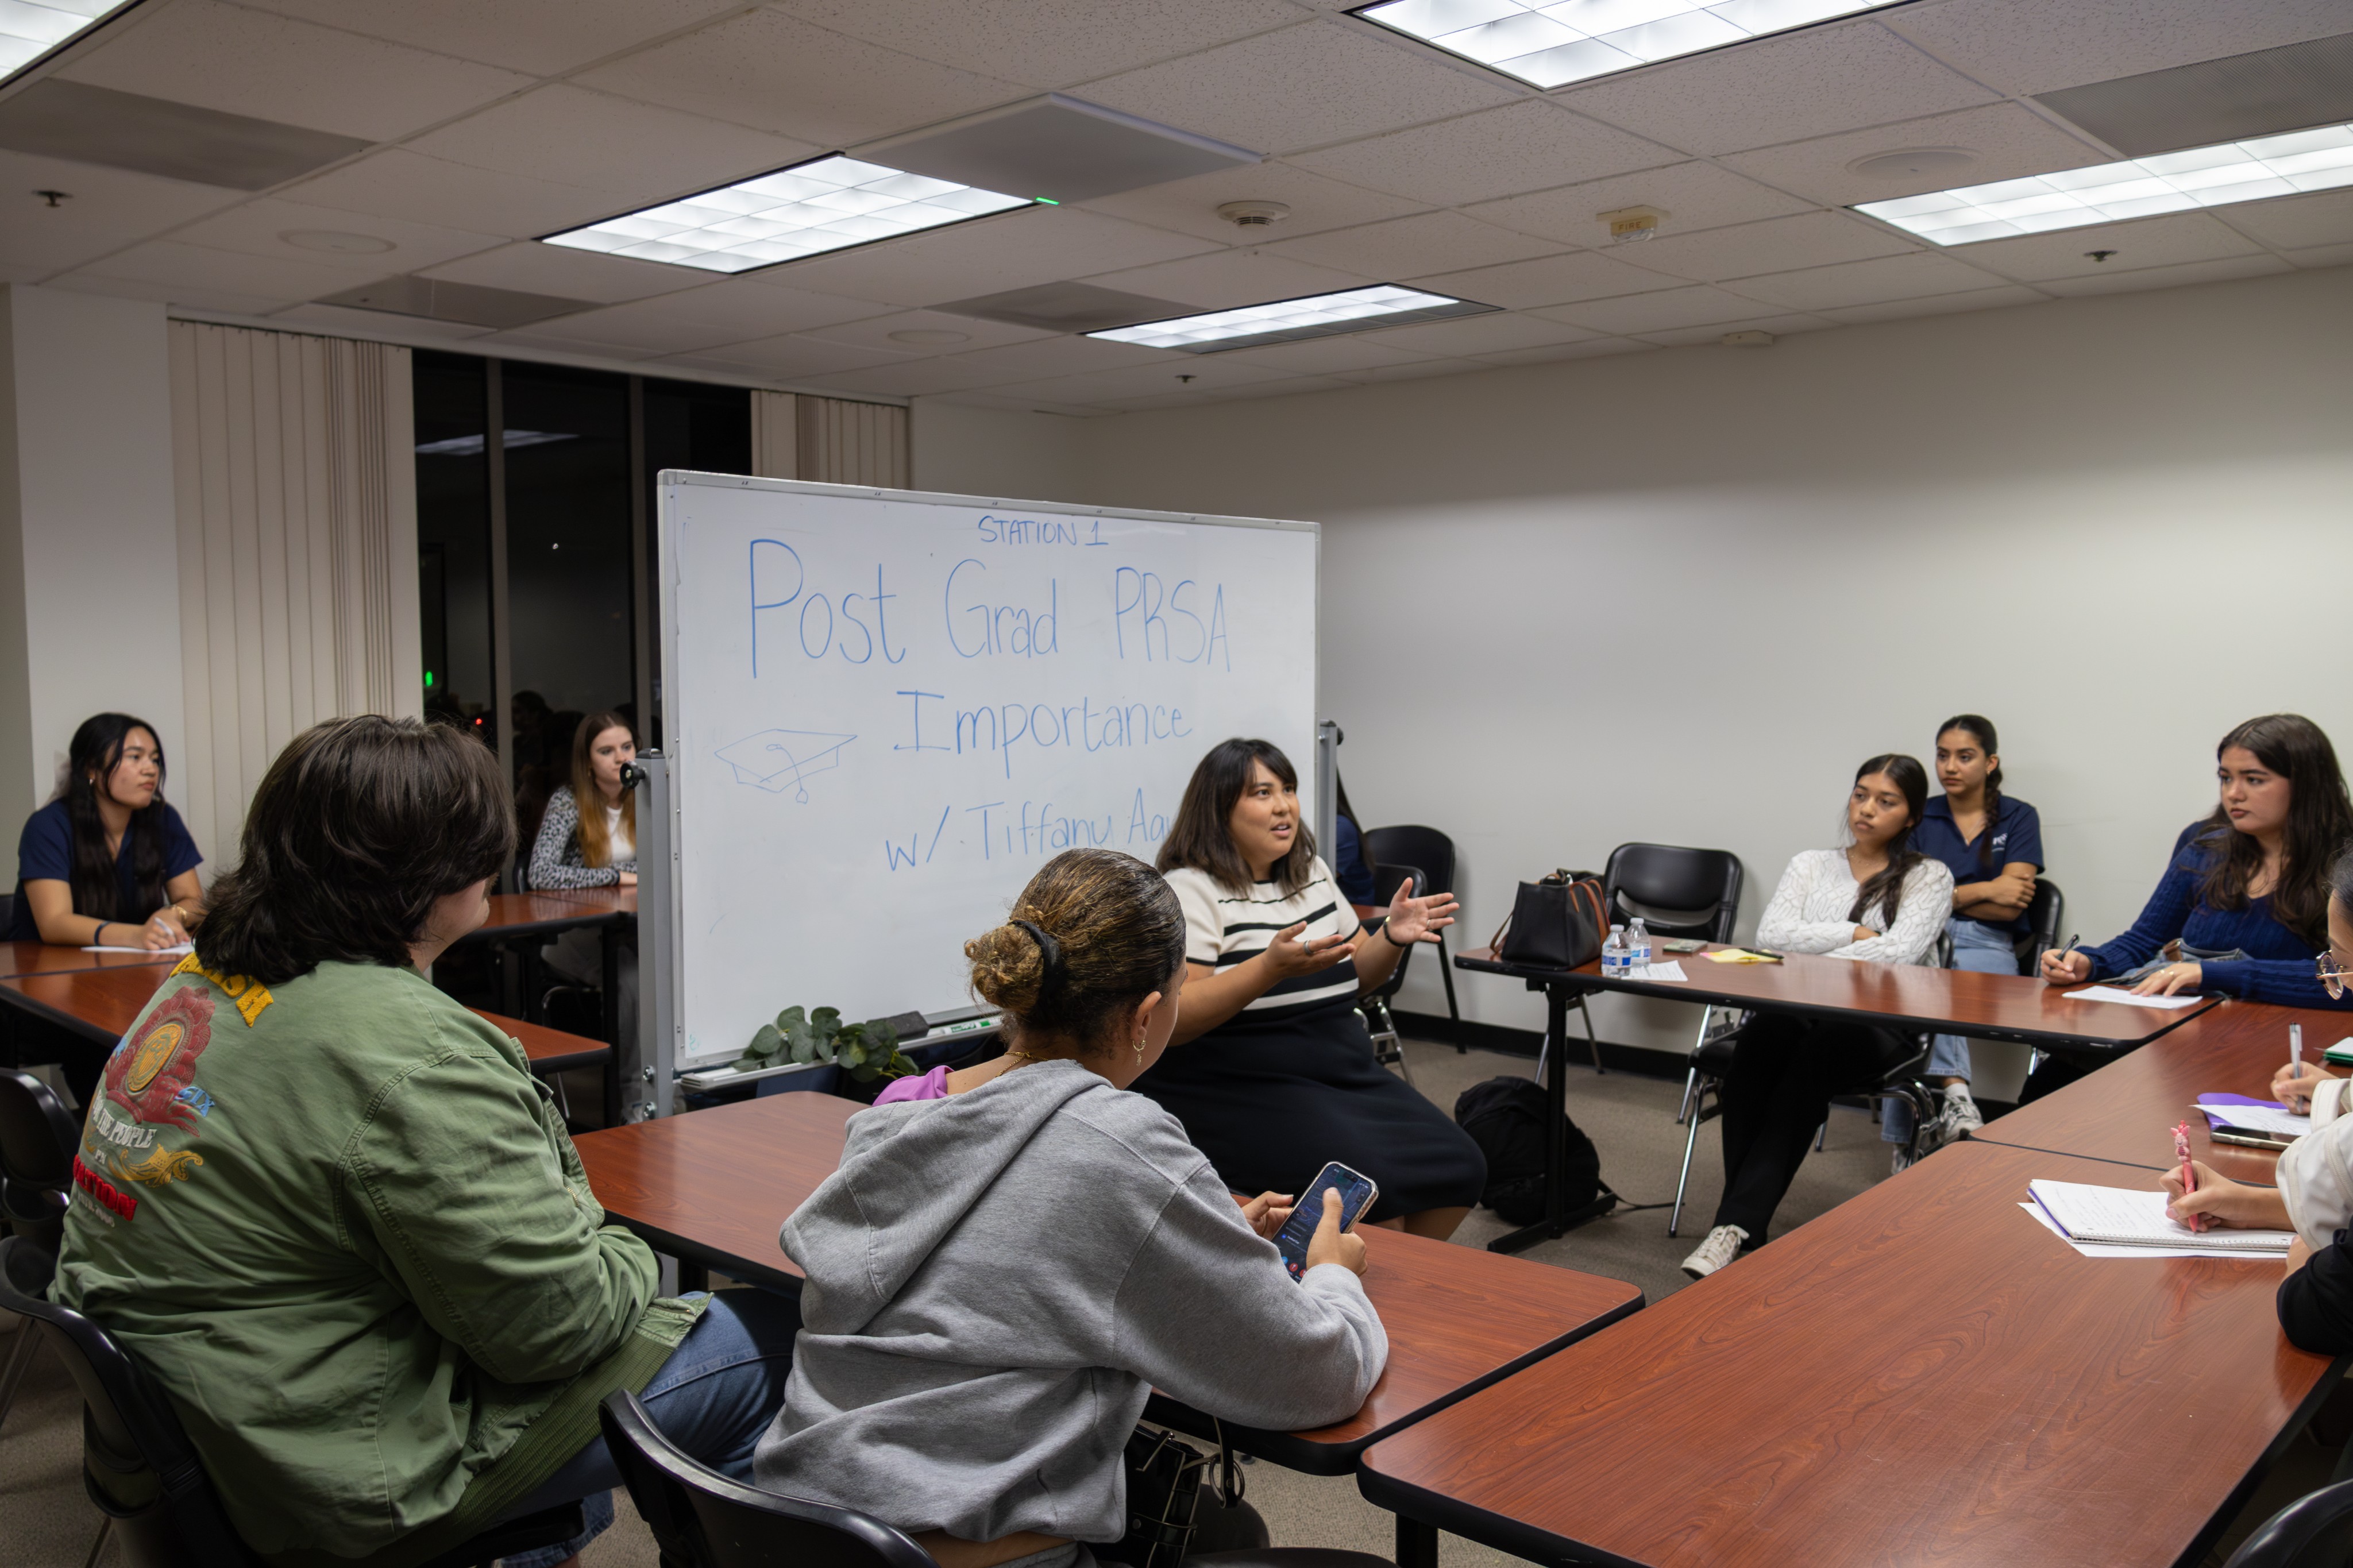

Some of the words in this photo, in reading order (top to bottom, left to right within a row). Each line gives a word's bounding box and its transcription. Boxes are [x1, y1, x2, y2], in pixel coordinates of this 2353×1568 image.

[1618, 221, 1642, 230] FIRE
[978, 516, 1078, 546] STATION
[1085, 519, 1109, 546] 1
[750, 539, 906, 679] Post
[946, 559, 1058, 658] Grad
[1116, 567, 1230, 671] PRSA
[894, 690, 1192, 779] Importance
[886, 806, 950, 872] w/
[97, 1107, 115, 1137] THE
[108, 1121, 157, 1148] PEOPLE
